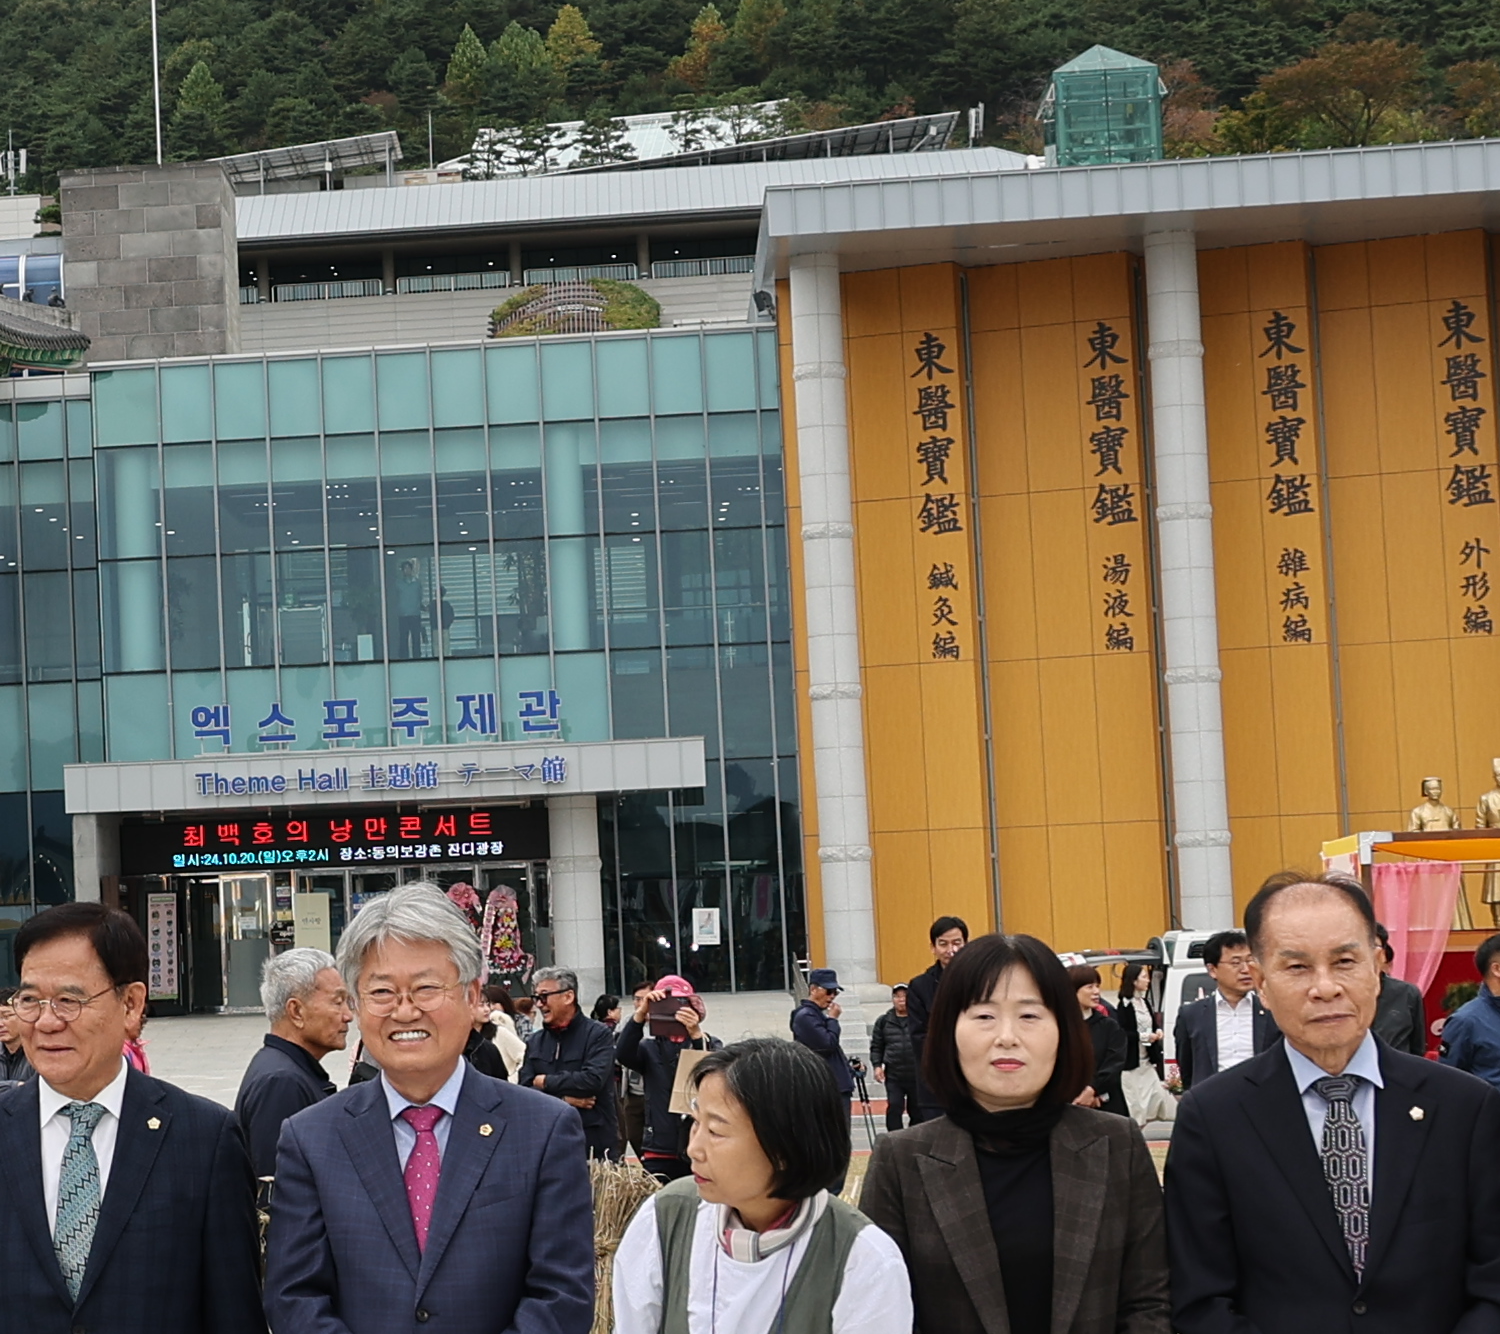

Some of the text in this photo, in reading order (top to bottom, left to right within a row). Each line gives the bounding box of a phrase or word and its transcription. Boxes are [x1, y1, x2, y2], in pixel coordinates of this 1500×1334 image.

[910, 332, 964, 536] 東醫寶鑑
[1258, 311, 1315, 517] 東醫寶鑑
[1437, 300, 1496, 635] 東醫寶鑑 外形編
[1083, 322, 1139, 652] 東醫寶鑑 湯液編
[190, 689, 562, 746] 엑스포주제관
[195, 772, 286, 796] Theme
[298, 768, 350, 792] Hall
[360, 761, 439, 791] 主題館
[183, 812, 493, 847] 최백호의 낭만콘서트
[448, 841, 504, 858] 잔디광장
